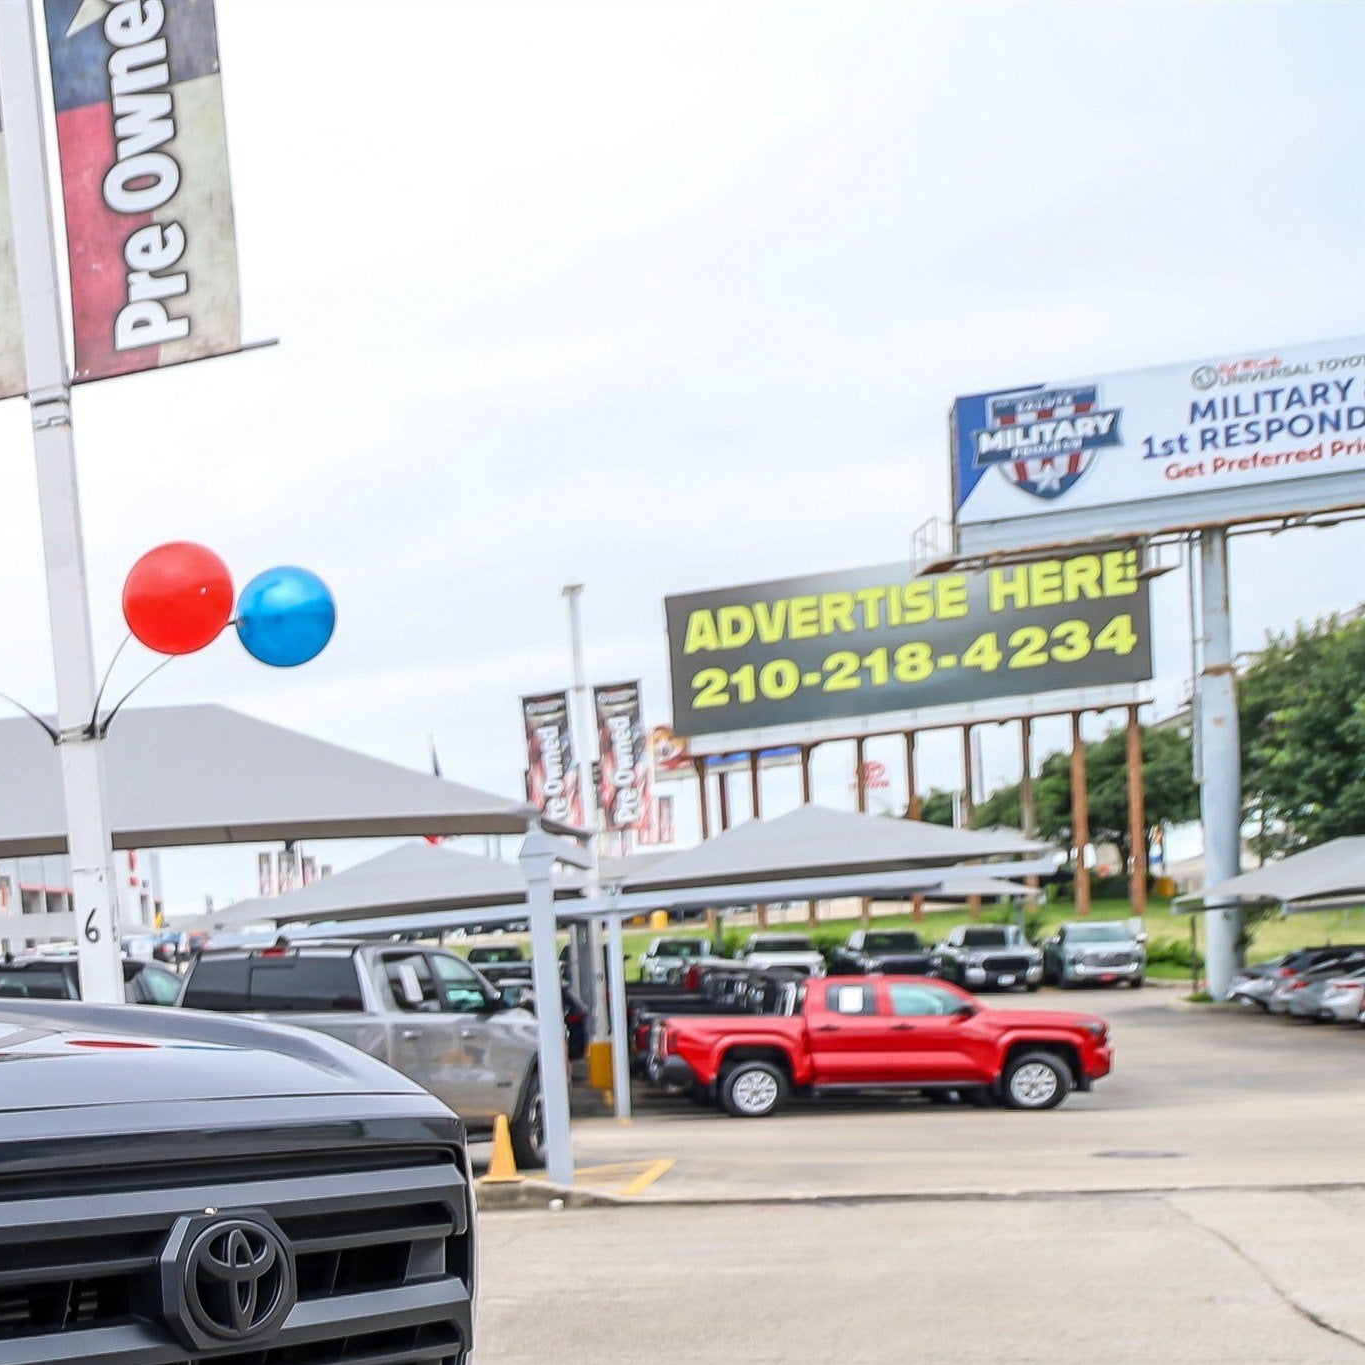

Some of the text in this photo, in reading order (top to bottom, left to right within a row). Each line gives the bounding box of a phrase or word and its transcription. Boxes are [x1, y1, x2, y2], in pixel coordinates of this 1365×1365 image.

[115, 222, 190, 350] Pre
[1189, 377, 1355, 425] MILITARY
[977, 411, 1116, 455] MILITARY
[1142, 433, 1189, 460] 1st
[1165, 462, 1204, 480] Get
[1213, 443, 1322, 473] Preferred
[684, 549, 1139, 655] ADVERTISE HERE
[690, 614, 1139, 710] 210-218-4234
[84, 906, 100, 944] 6
